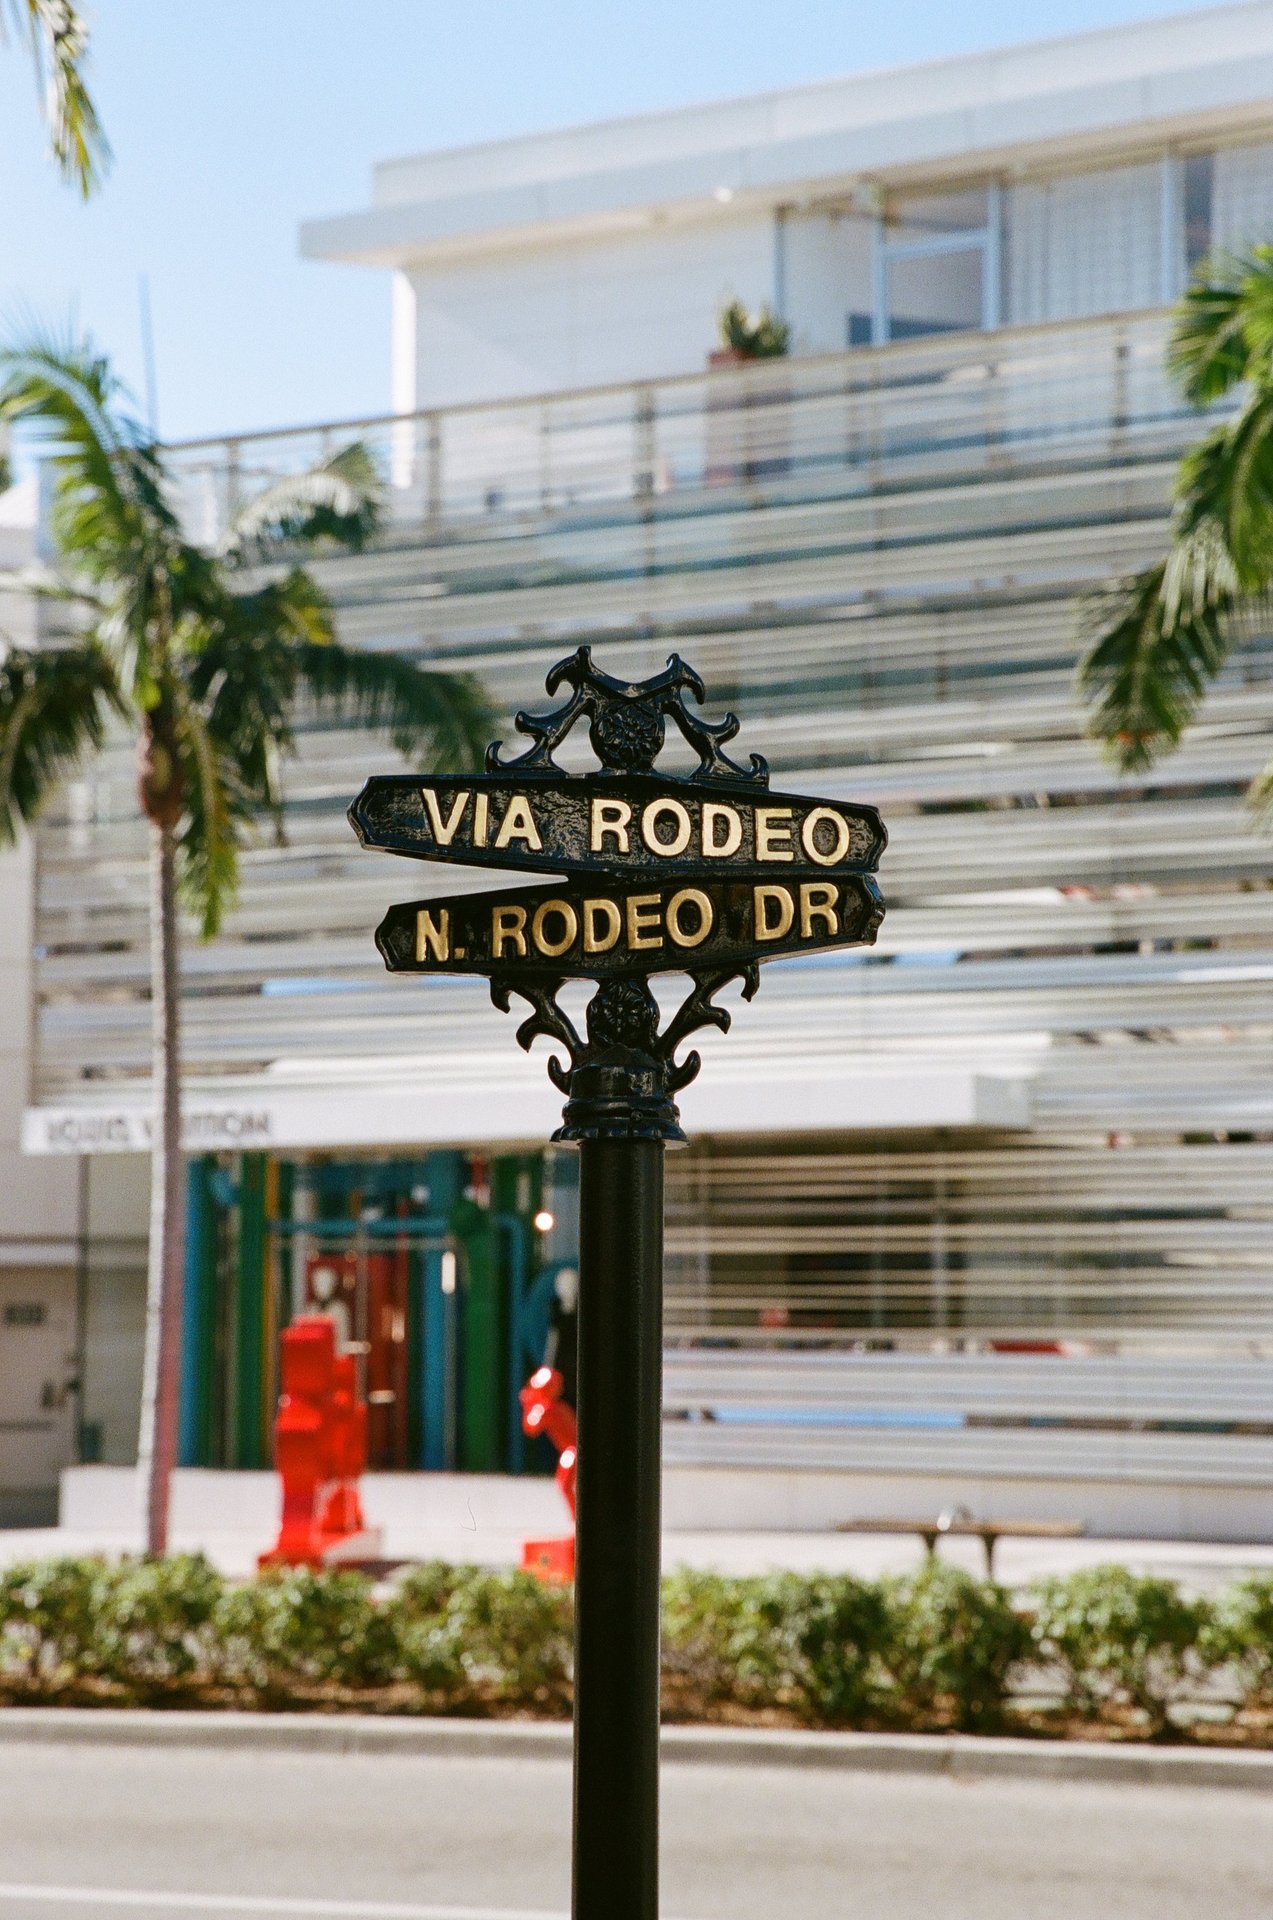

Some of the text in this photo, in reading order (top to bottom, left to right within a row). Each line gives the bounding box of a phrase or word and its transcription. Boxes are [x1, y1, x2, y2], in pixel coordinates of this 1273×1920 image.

[422, 788, 851, 867] VIA RODEO
[415, 881, 840, 962] N. RODEO DR
